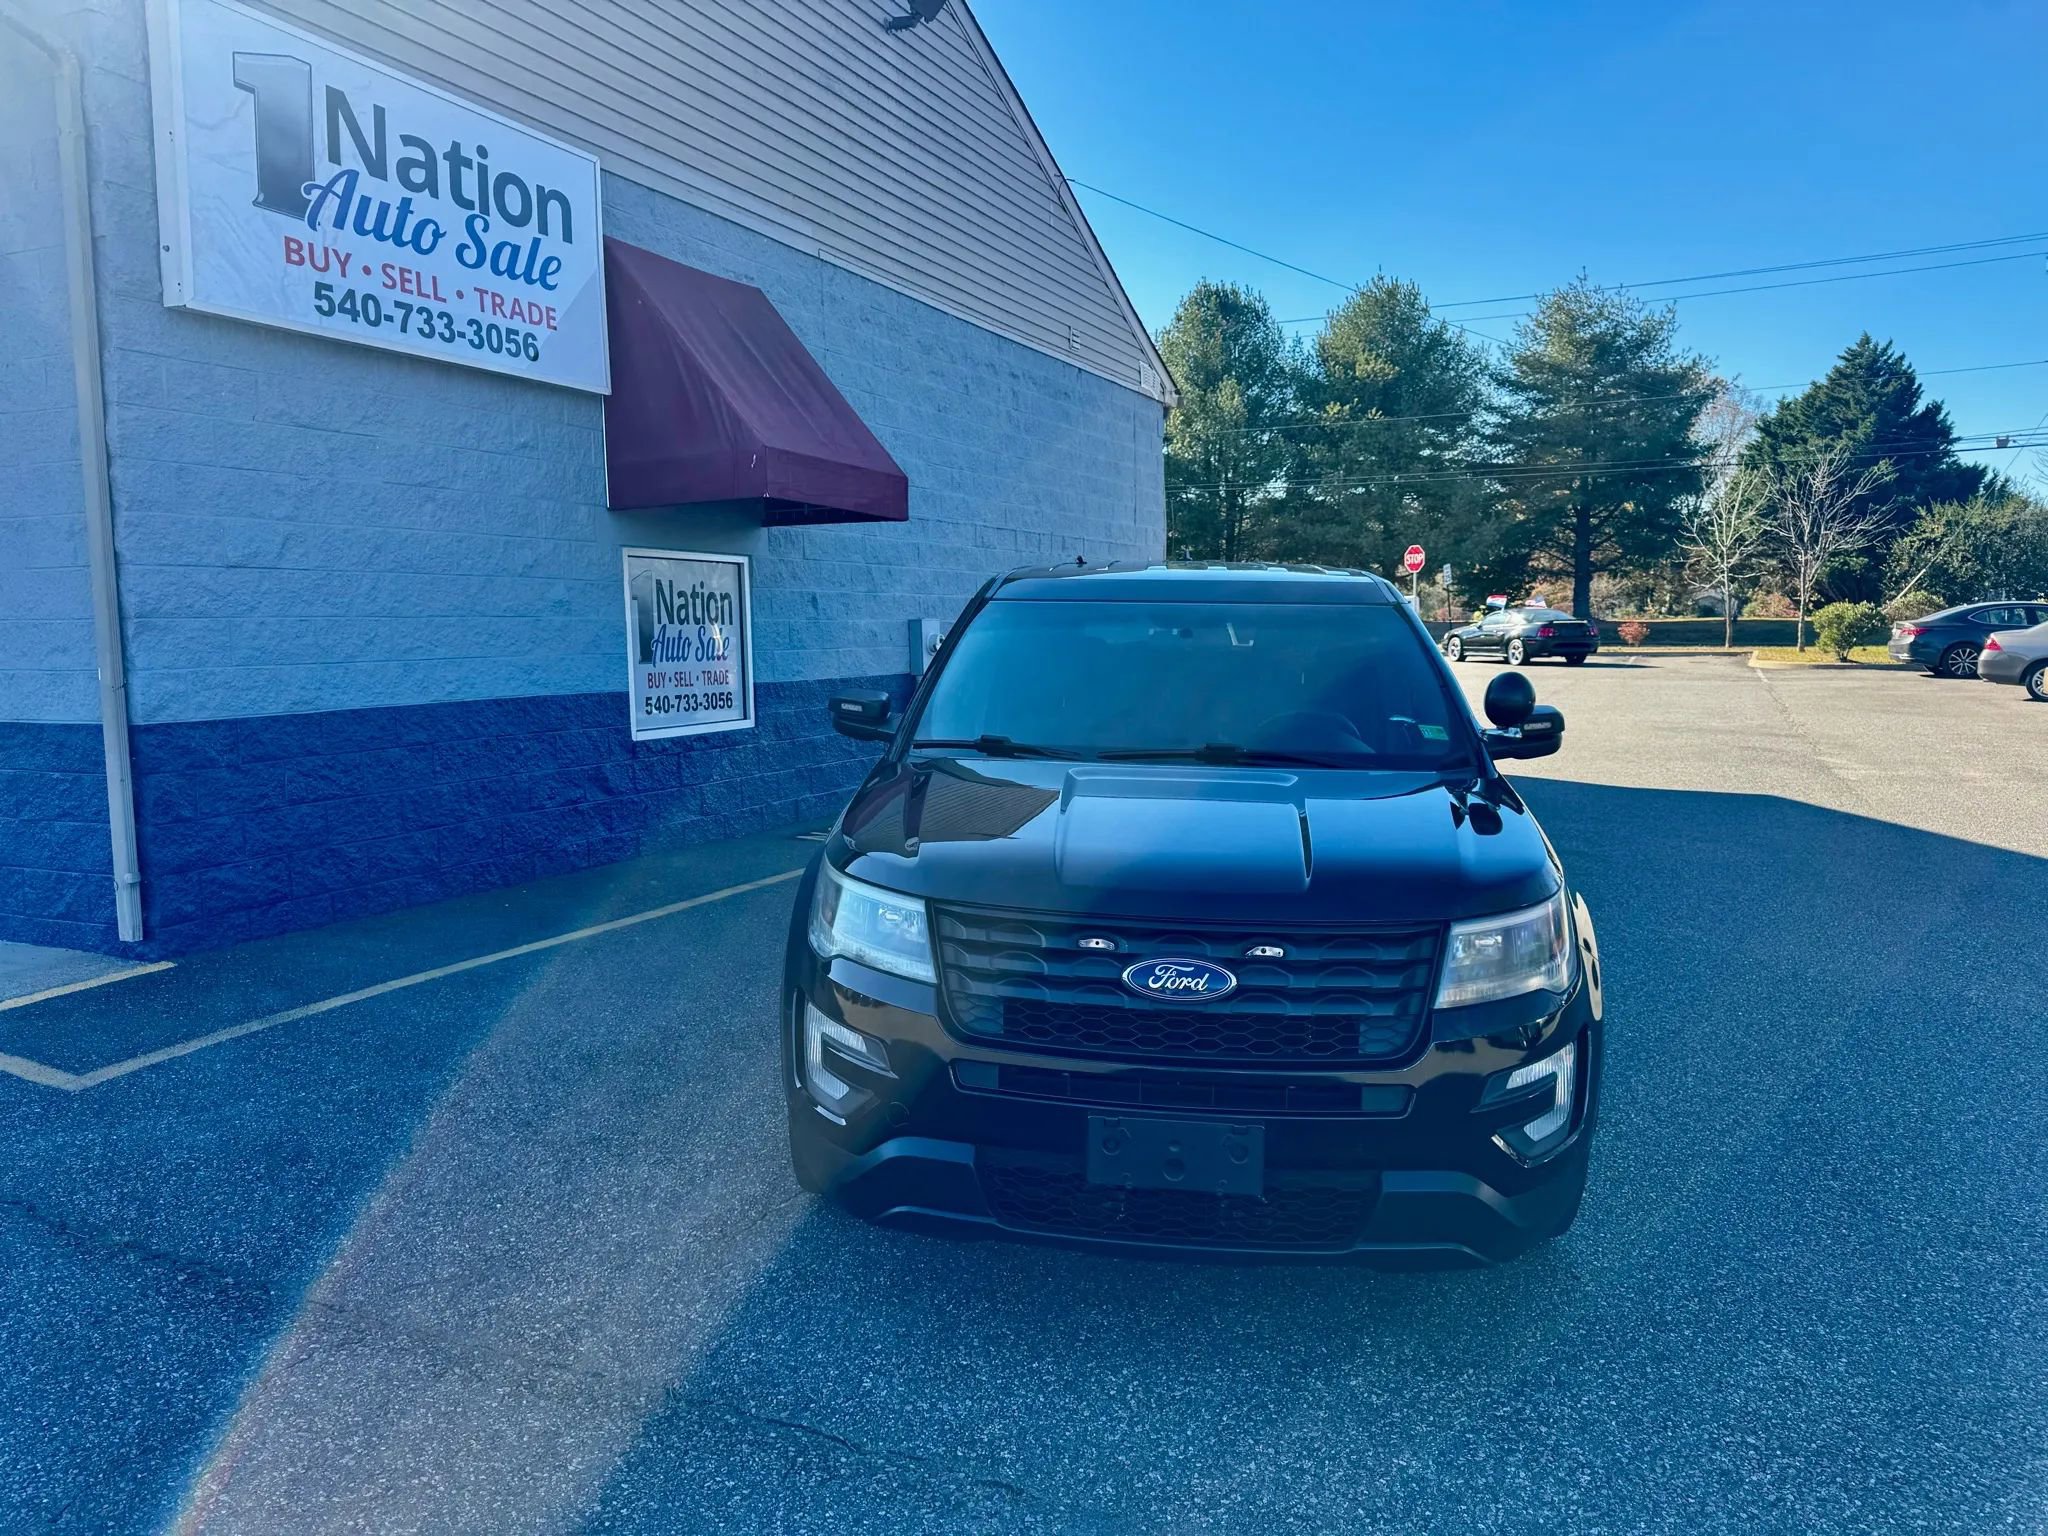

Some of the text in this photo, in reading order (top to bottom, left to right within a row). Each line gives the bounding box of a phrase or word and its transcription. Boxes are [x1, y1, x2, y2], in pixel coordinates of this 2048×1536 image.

[325, 84, 573, 245] Nation
[302, 168, 563, 291] Auto Sale
[284, 235, 558, 331] BUY SELL TRADE
[313, 281, 540, 362] 540-733-3056
[1406, 553, 1424, 564] STOP
[656, 579, 733, 625] Nation
[651, 624, 692, 668] Auto
[647, 670, 729, 689] BUY SELL TRADE
[645, 692, 733, 715] 540-733-3056
[1148, 964, 1209, 991] Ford
